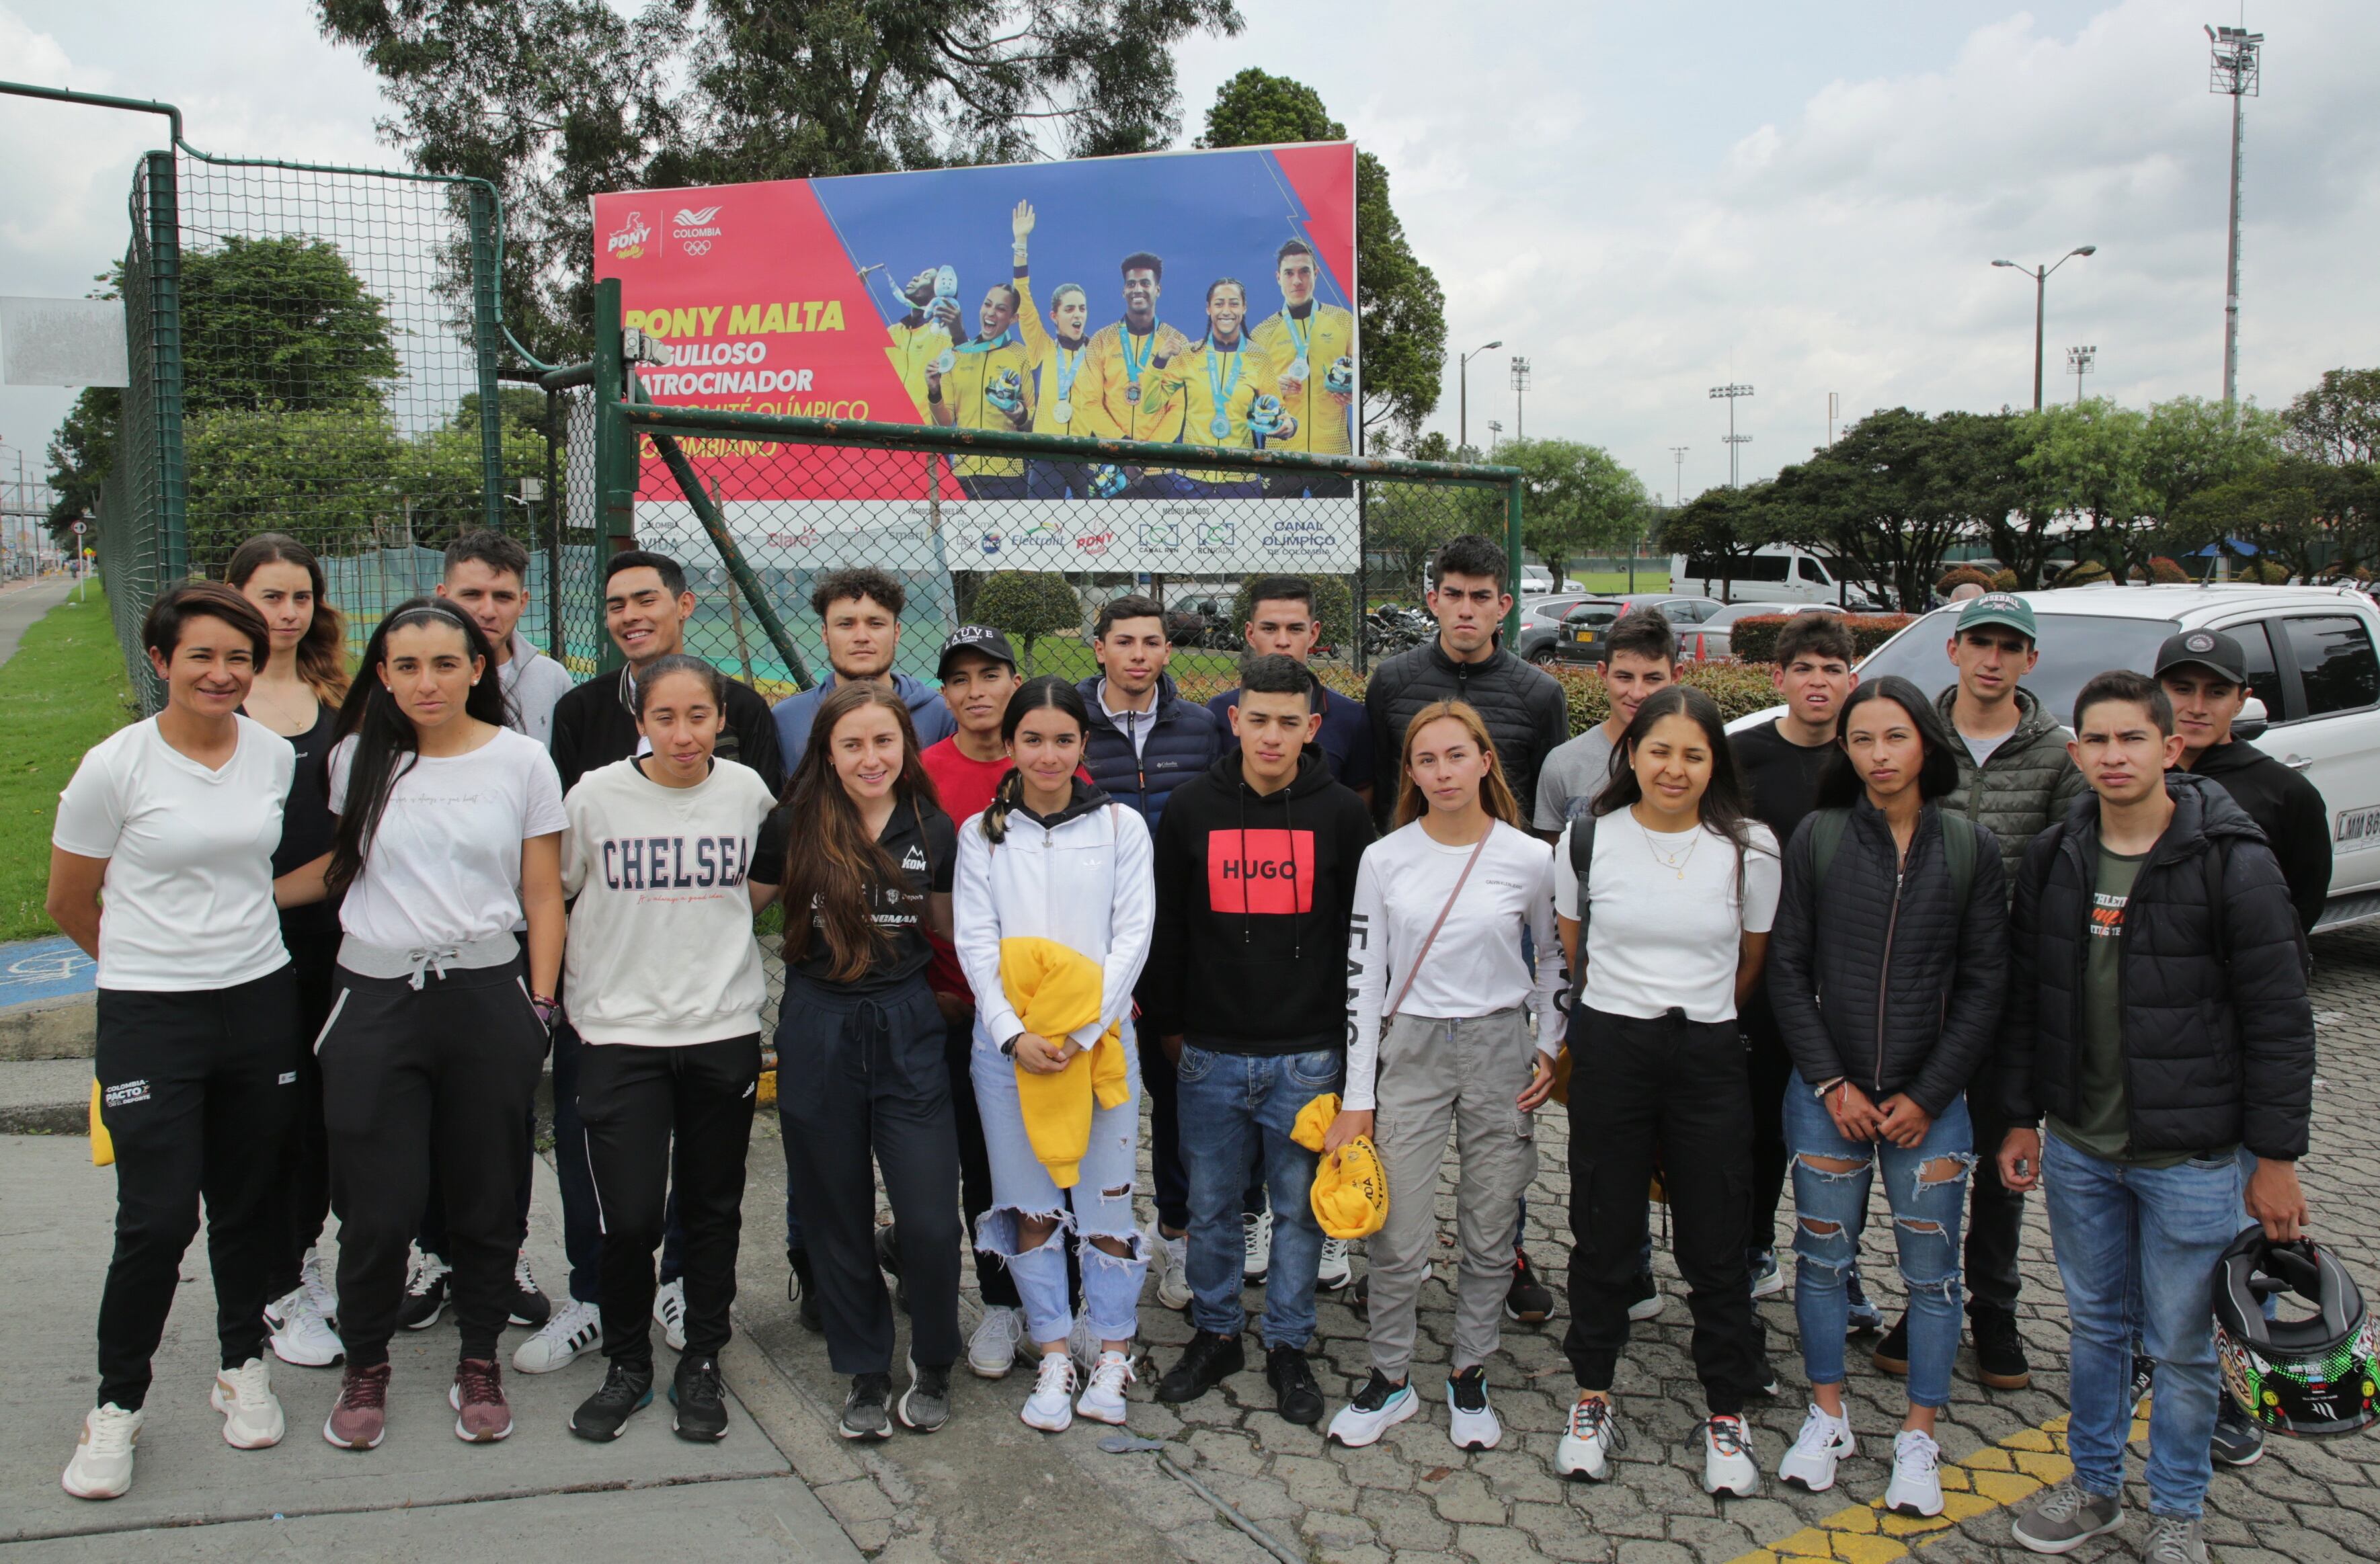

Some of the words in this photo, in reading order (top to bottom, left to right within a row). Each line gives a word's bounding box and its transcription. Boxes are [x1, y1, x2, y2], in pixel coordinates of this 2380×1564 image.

[608, 227, 651, 252] PONY
[673, 227, 721, 238] COLOMBIA
[625, 303, 723, 338] PONY
[727, 300, 845, 335] MALTA
[639, 369, 814, 397] ATROCINADOR
[1274, 522, 1324, 531] CANAL
[766, 532, 810, 547] Claro
[889, 530, 924, 540] smart
[1012, 535, 1065, 546] Electrolit
[1076, 532, 1115, 549] PONY
[1263, 534, 1336, 546] OLÍMPICO
[641, 538, 681, 551] VIDA
[1978, 595, 2020, 609] BASEBALL
[2337, 813, 2365, 841] LMM
[2365, 810, 2380, 837] 86
[602, 836, 748, 891] CHELSEA
[902, 858, 926, 871] KOM
[1223, 860, 1297, 880] HUGO
[107, 1079, 146, 1093] COLOMBIA
[106, 1087, 142, 1102] PACTO
[122, 1094, 151, 1104] DEPORTE
